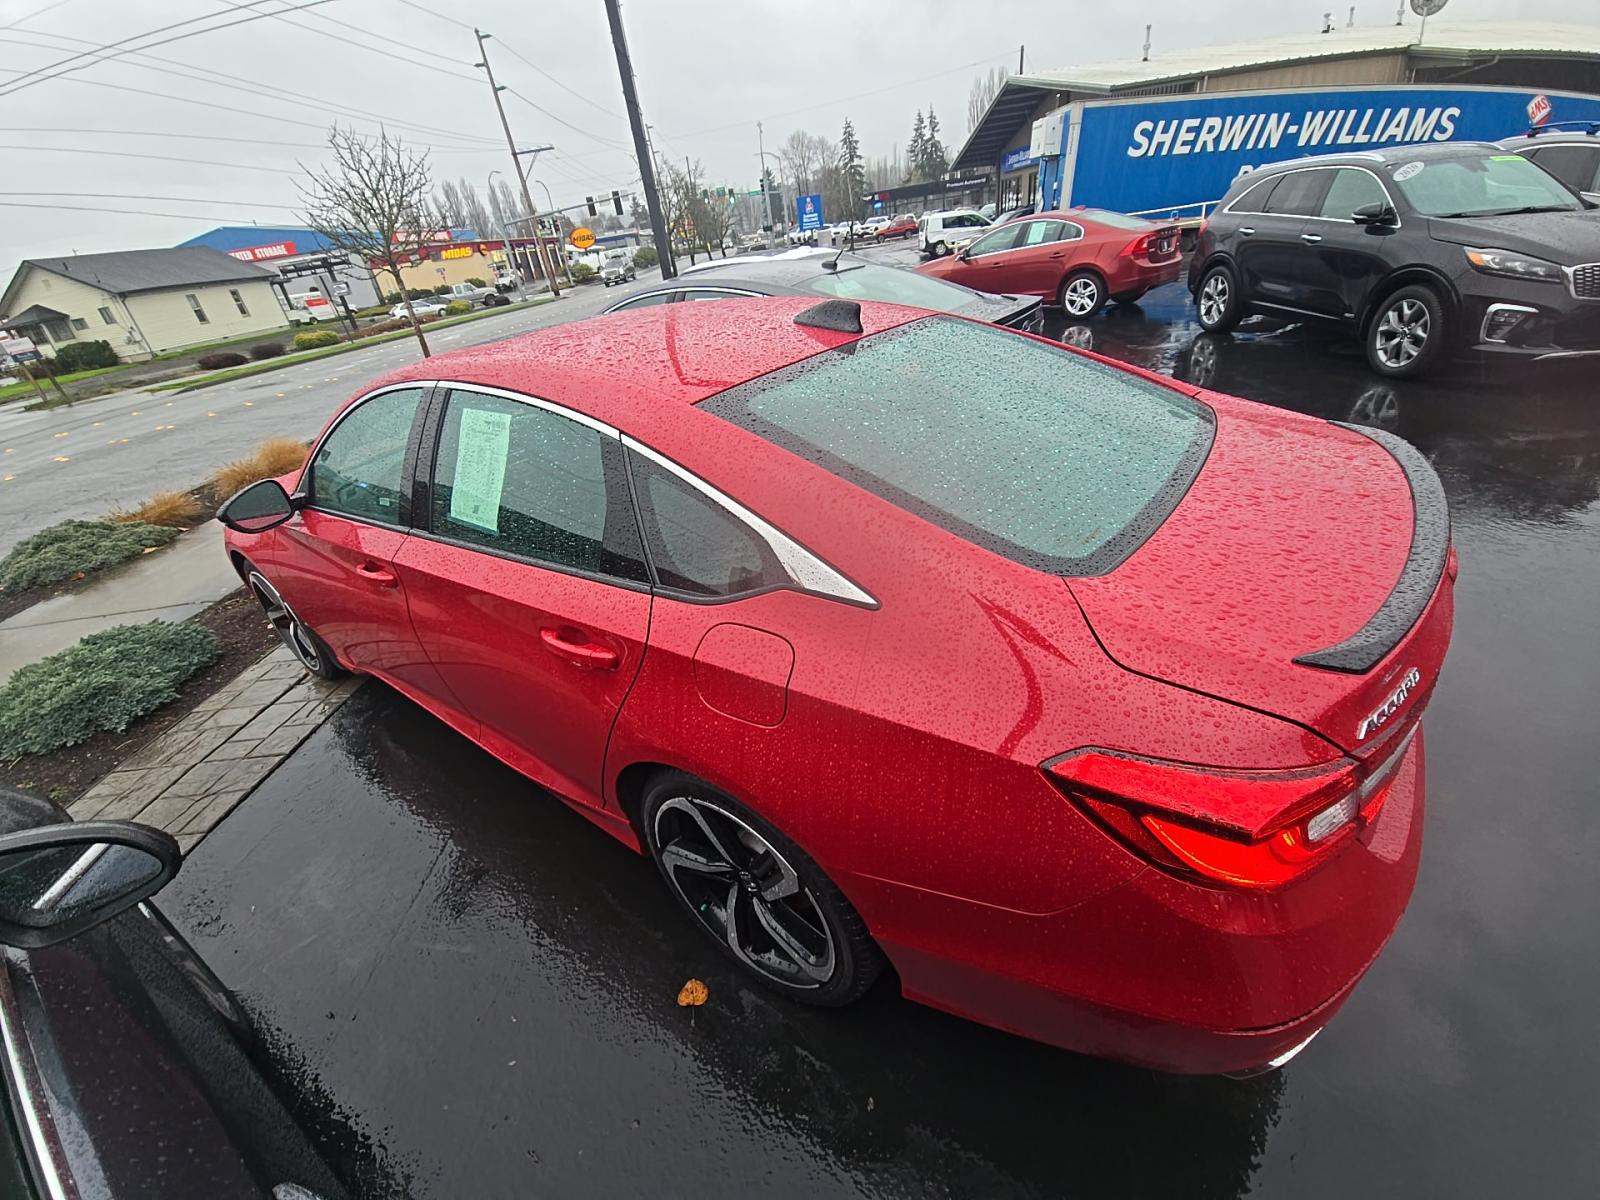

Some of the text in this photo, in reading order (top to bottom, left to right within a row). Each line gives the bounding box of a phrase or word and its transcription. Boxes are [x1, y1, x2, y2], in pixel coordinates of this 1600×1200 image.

[1126, 107, 1461, 158] SHERWIN-WILLIAMS
[572, 234, 594, 244] MIDAS
[254, 244, 289, 259] STORAGE
[441, 246, 474, 261] MIDAS
